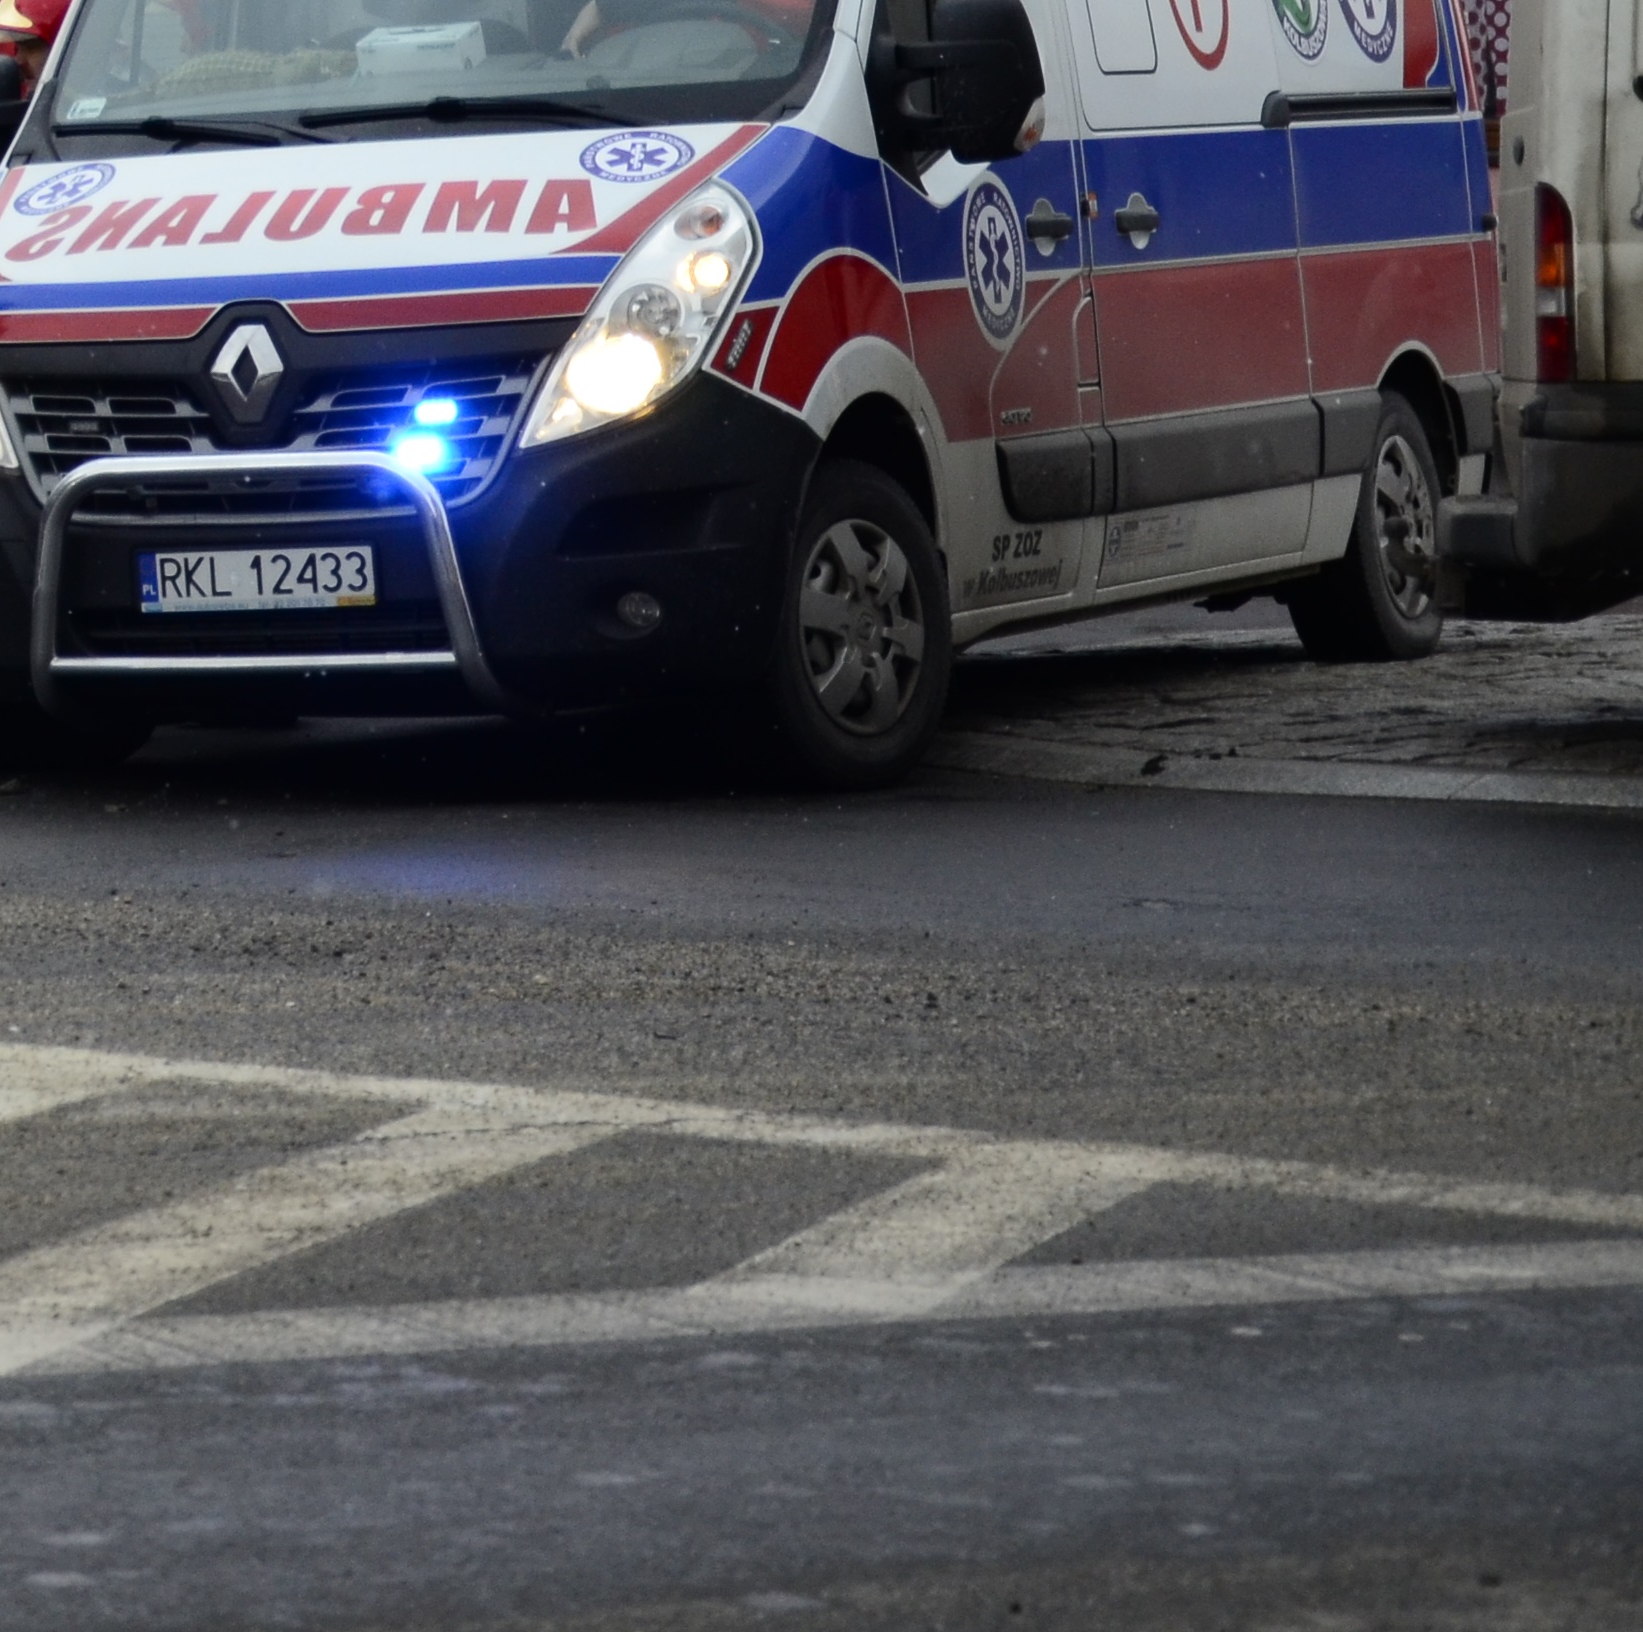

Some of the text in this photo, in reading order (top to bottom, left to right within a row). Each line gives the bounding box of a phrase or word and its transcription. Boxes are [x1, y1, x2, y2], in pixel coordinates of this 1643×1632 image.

[991, 530, 1042, 562] SP ZOZ
[142, 584, 157, 596] PL
[159, 550, 368, 599] RKL 12433
[976, 559, 1063, 597] Kolbuszowej
